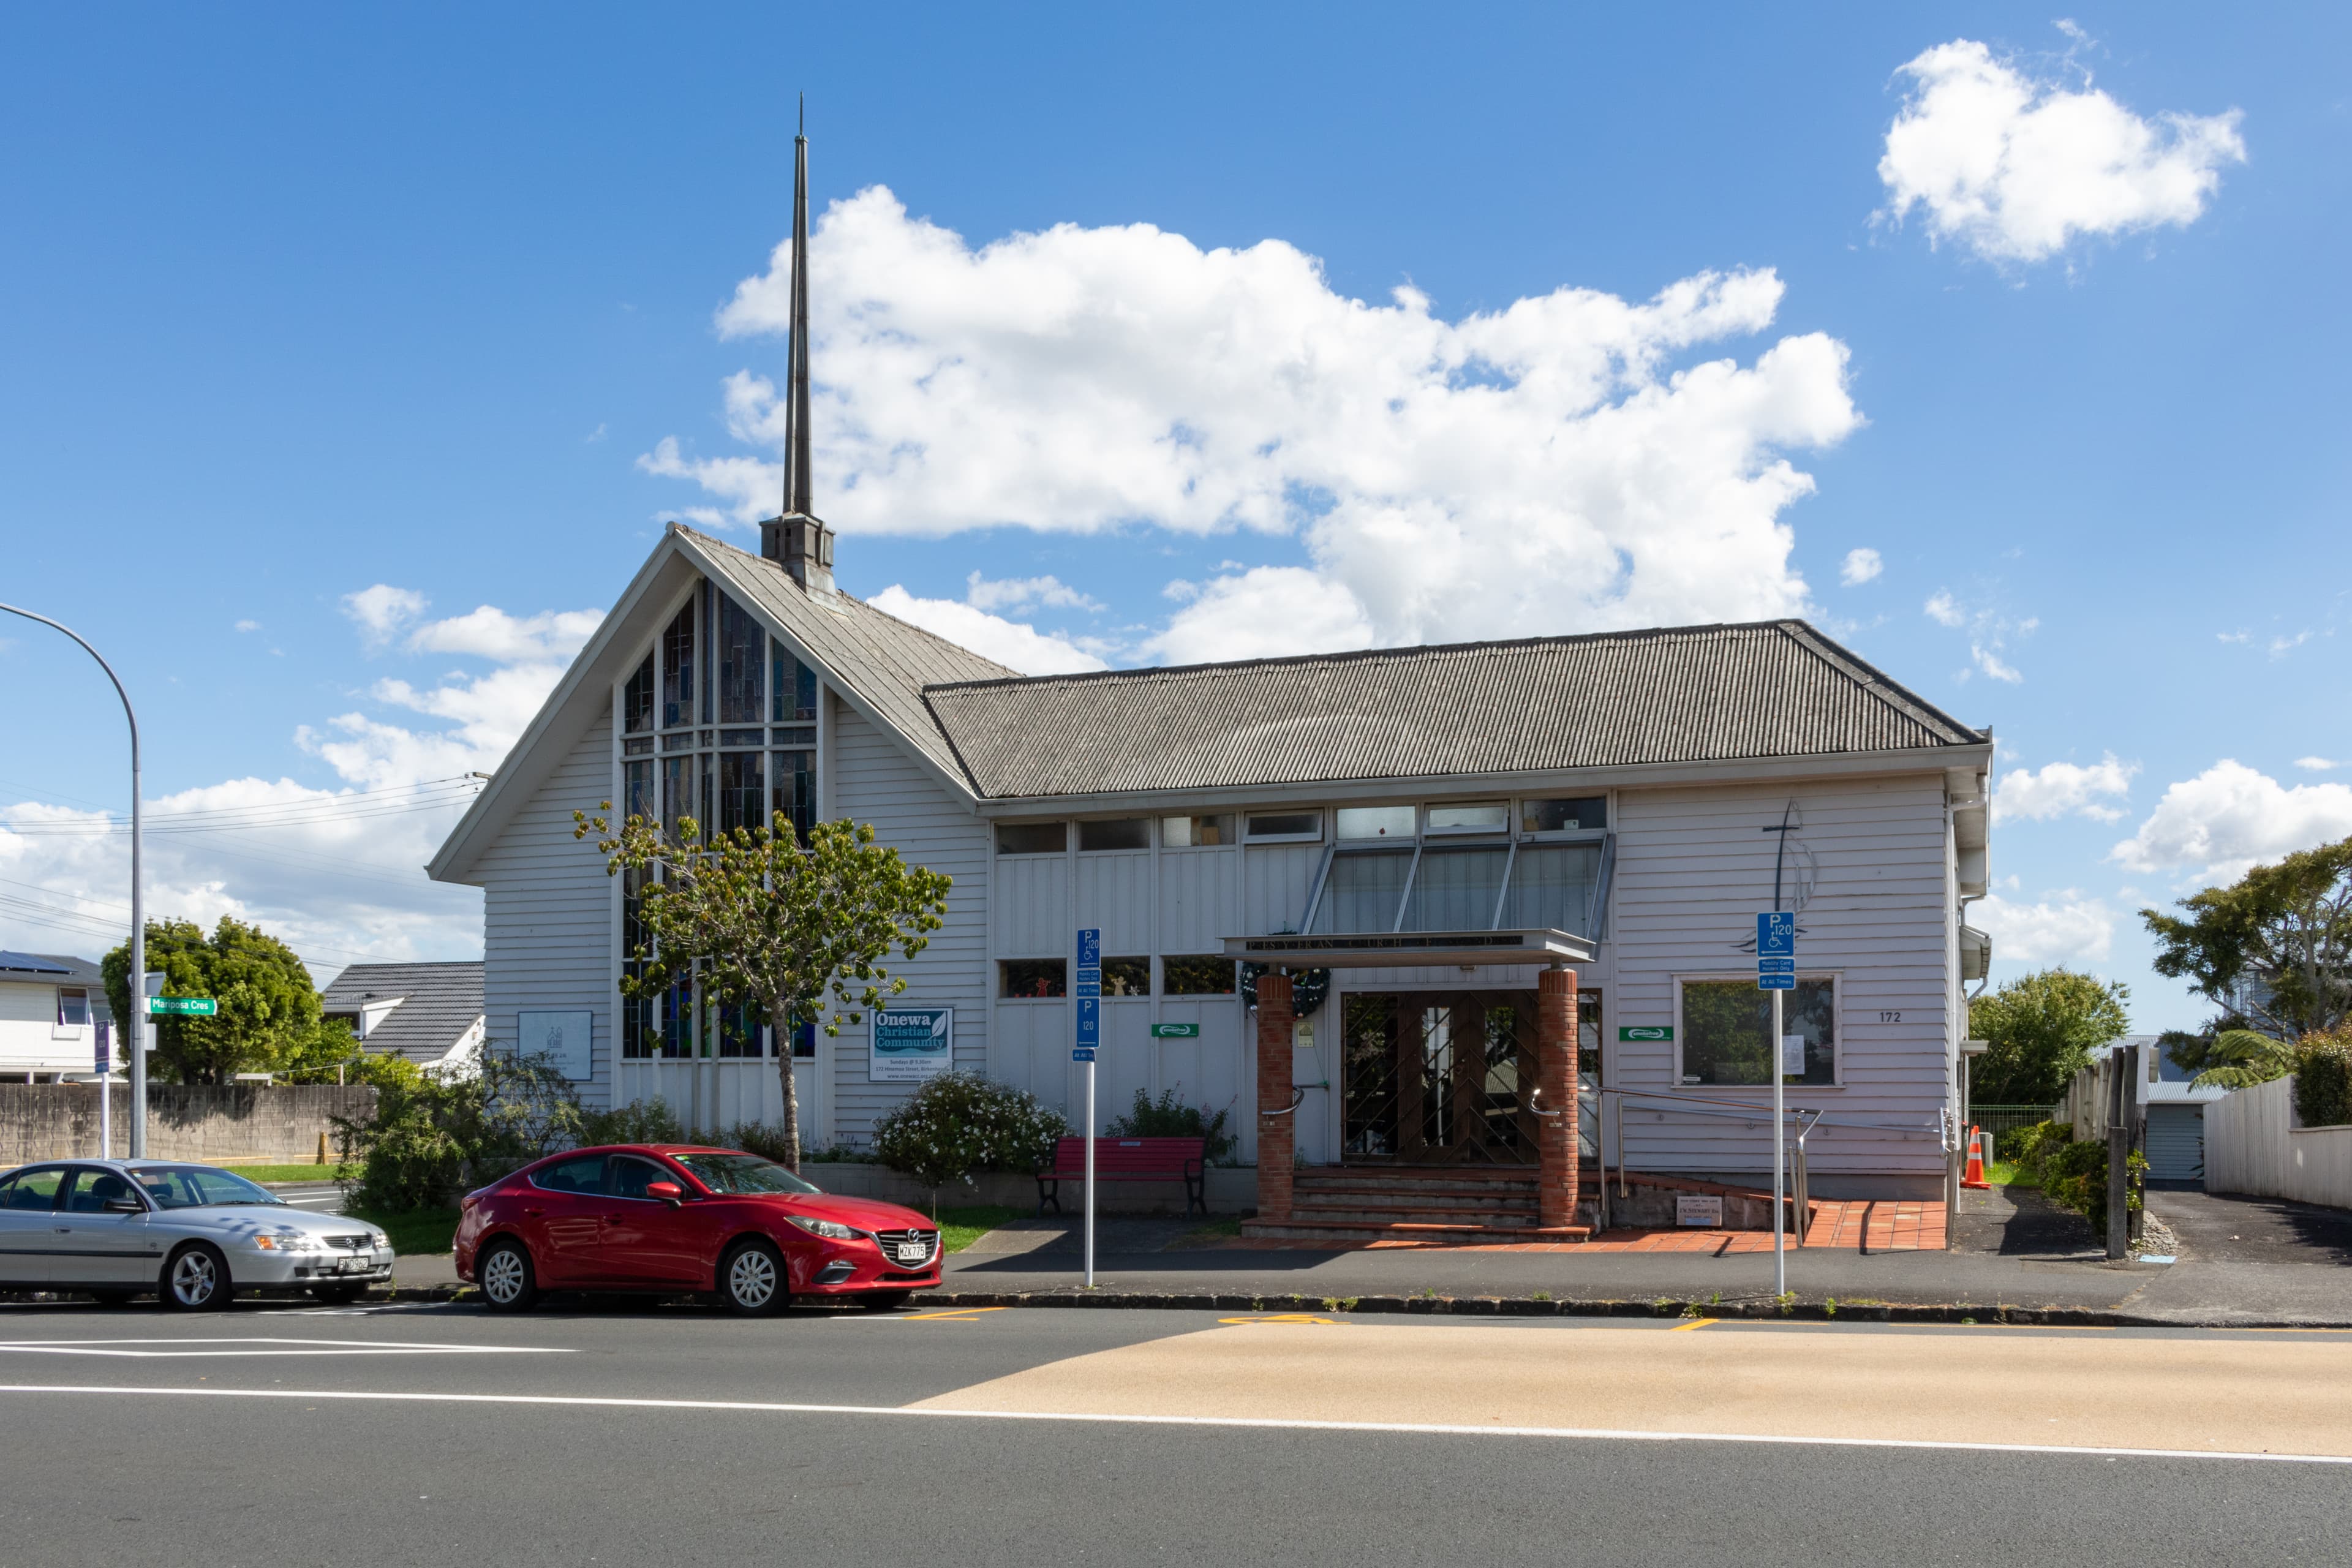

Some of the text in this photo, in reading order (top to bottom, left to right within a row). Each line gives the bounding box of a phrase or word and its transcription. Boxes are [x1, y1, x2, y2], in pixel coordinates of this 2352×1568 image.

[1770, 914, 1781, 928] P
[1775, 924, 1792, 935] 120
[1085, 931, 1092, 943] P
[1088, 940, 1099, 949] 120
[152, 998, 209, 1010] Mariposa Cres
[1085, 1001, 1092, 1013] P
[876, 1012, 931, 1026] Onewa
[1880, 1012, 1901, 1022] 172
[99, 1023, 105, 1034] P
[1083, 1020, 1094, 1030] 120
[876, 1026, 932, 1036] Christian
[876, 1037, 945, 1049] Community
[900, 1246, 925, 1257] MZK775
[339, 1259, 368, 1270] BND962
